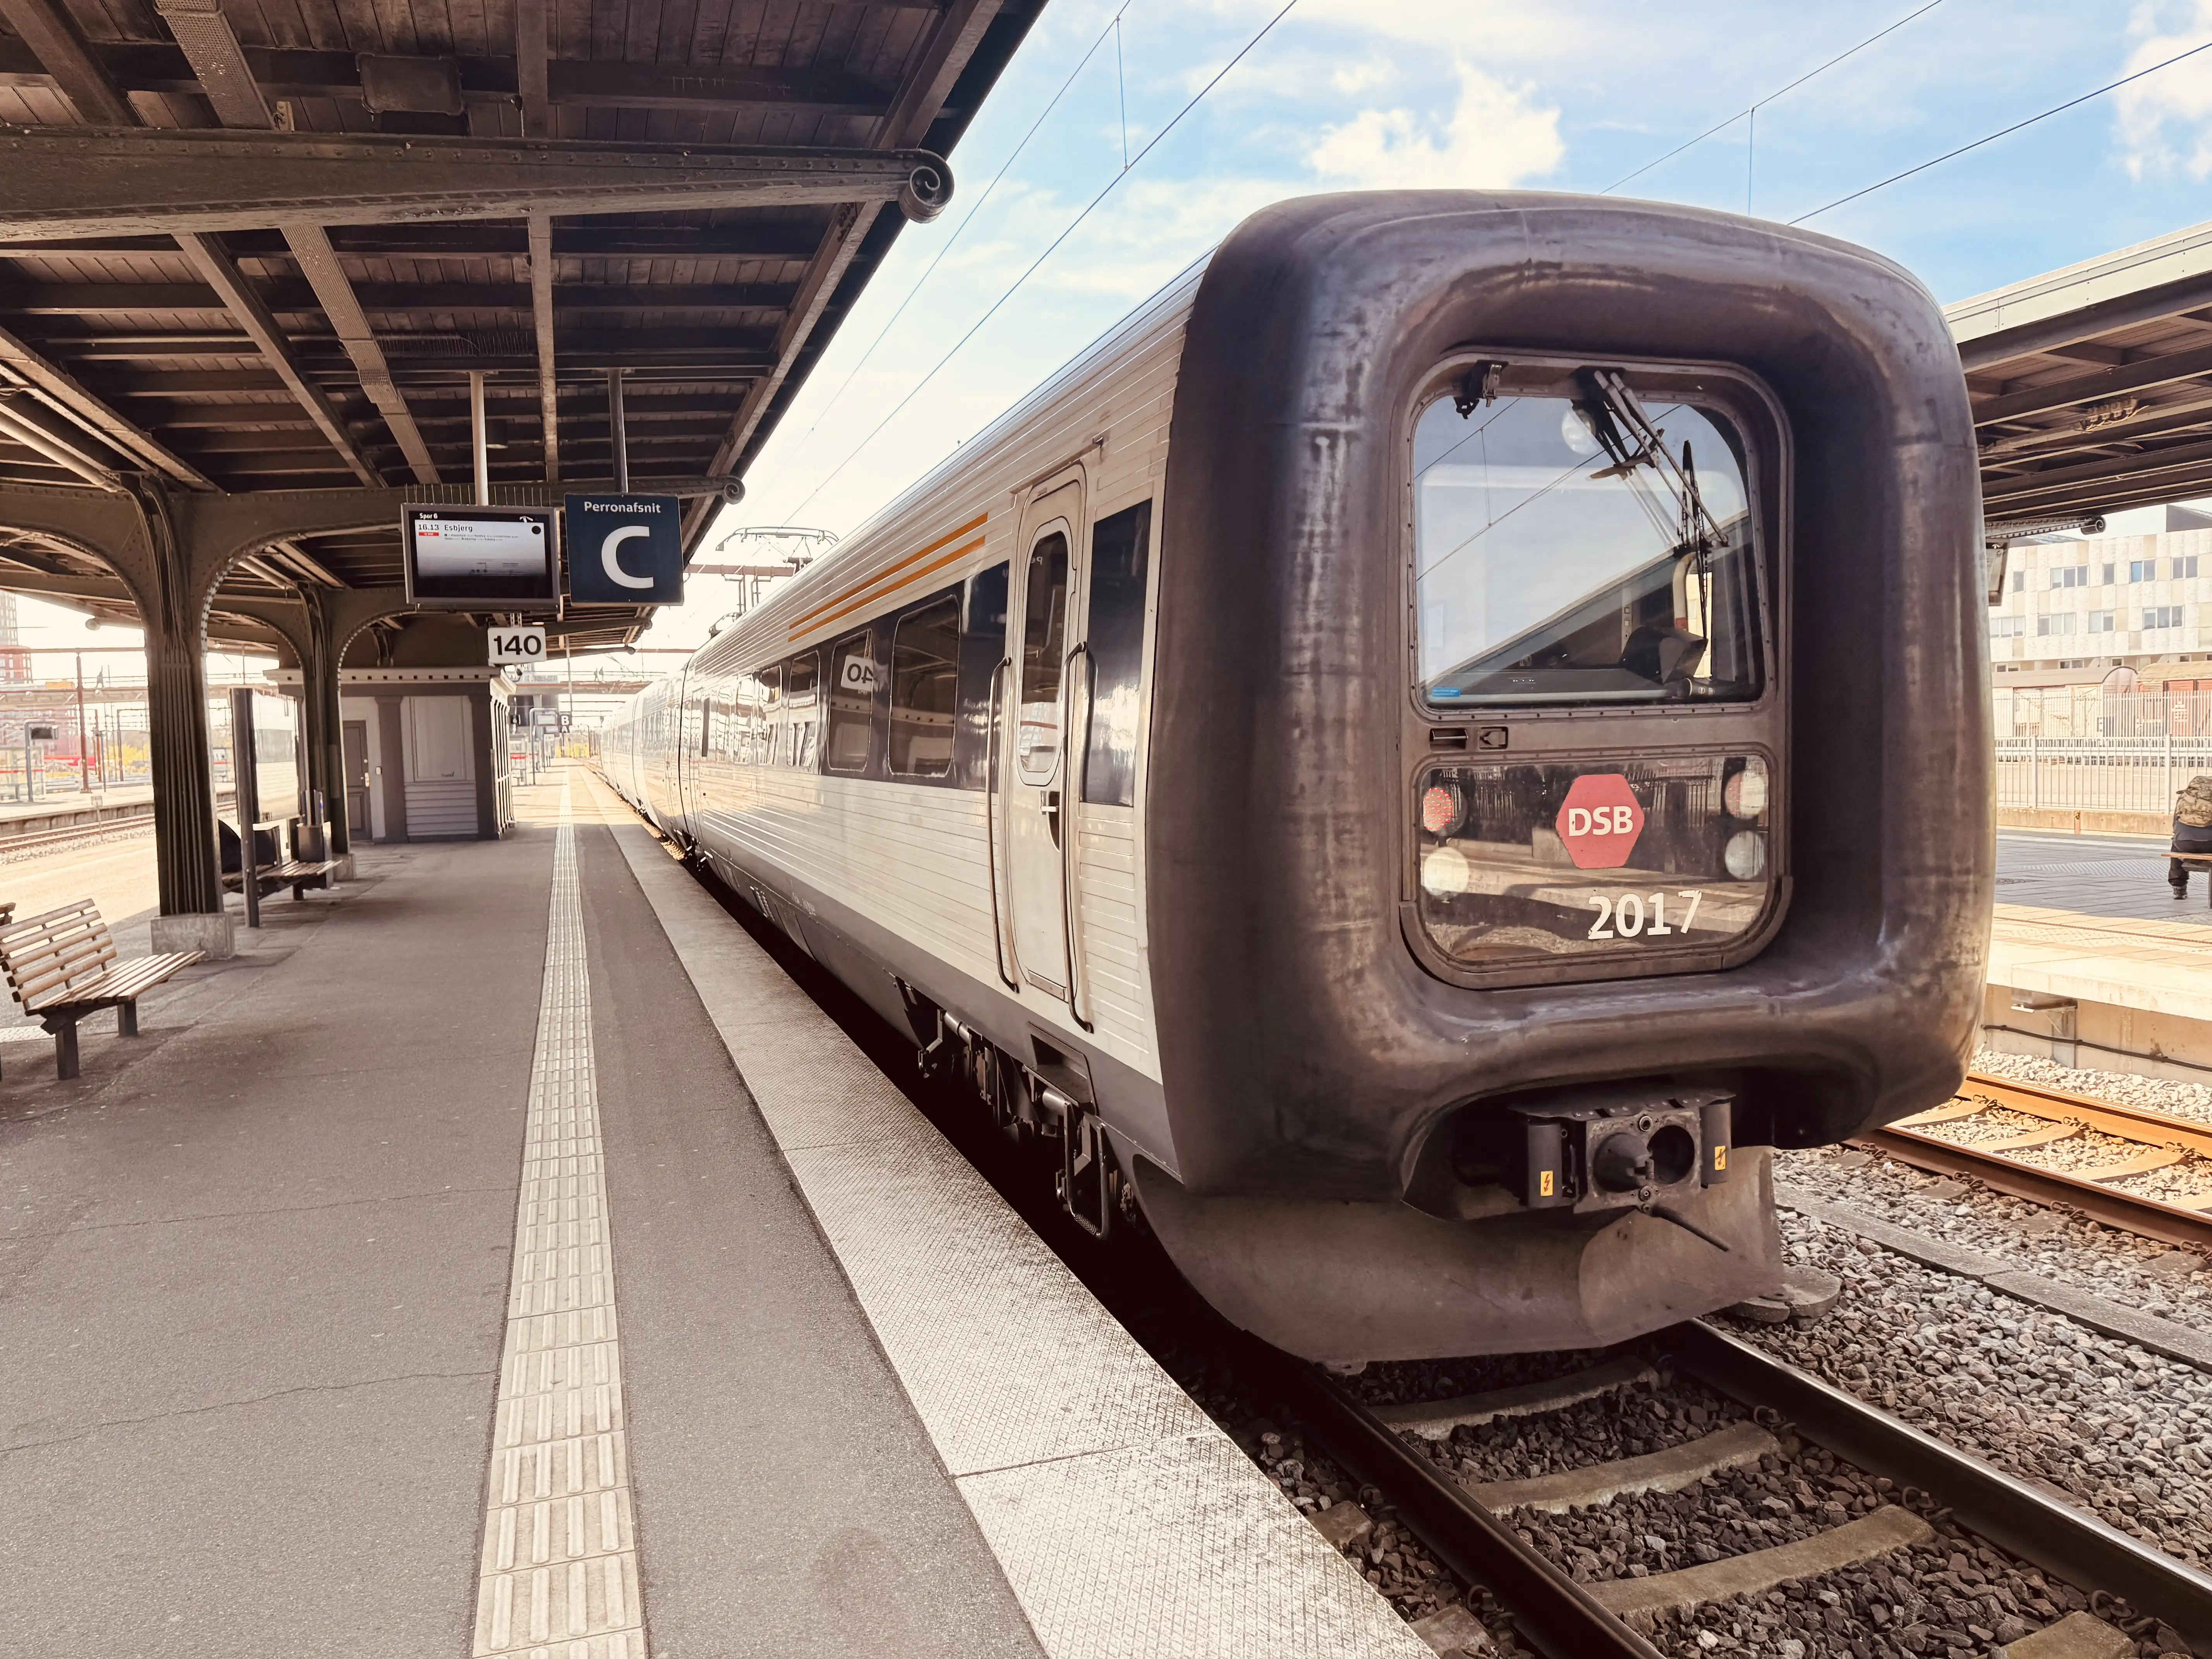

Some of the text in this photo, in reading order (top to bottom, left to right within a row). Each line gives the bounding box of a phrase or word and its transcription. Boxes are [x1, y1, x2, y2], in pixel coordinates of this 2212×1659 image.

[584, 501, 661, 513] Perronafsnit
[601, 526, 654, 589] C
[493, 635, 541, 655] 140
[561, 715, 569, 725] B
[1568, 806, 1633, 836] DSB
[1588, 890, 1703, 940] 2017
